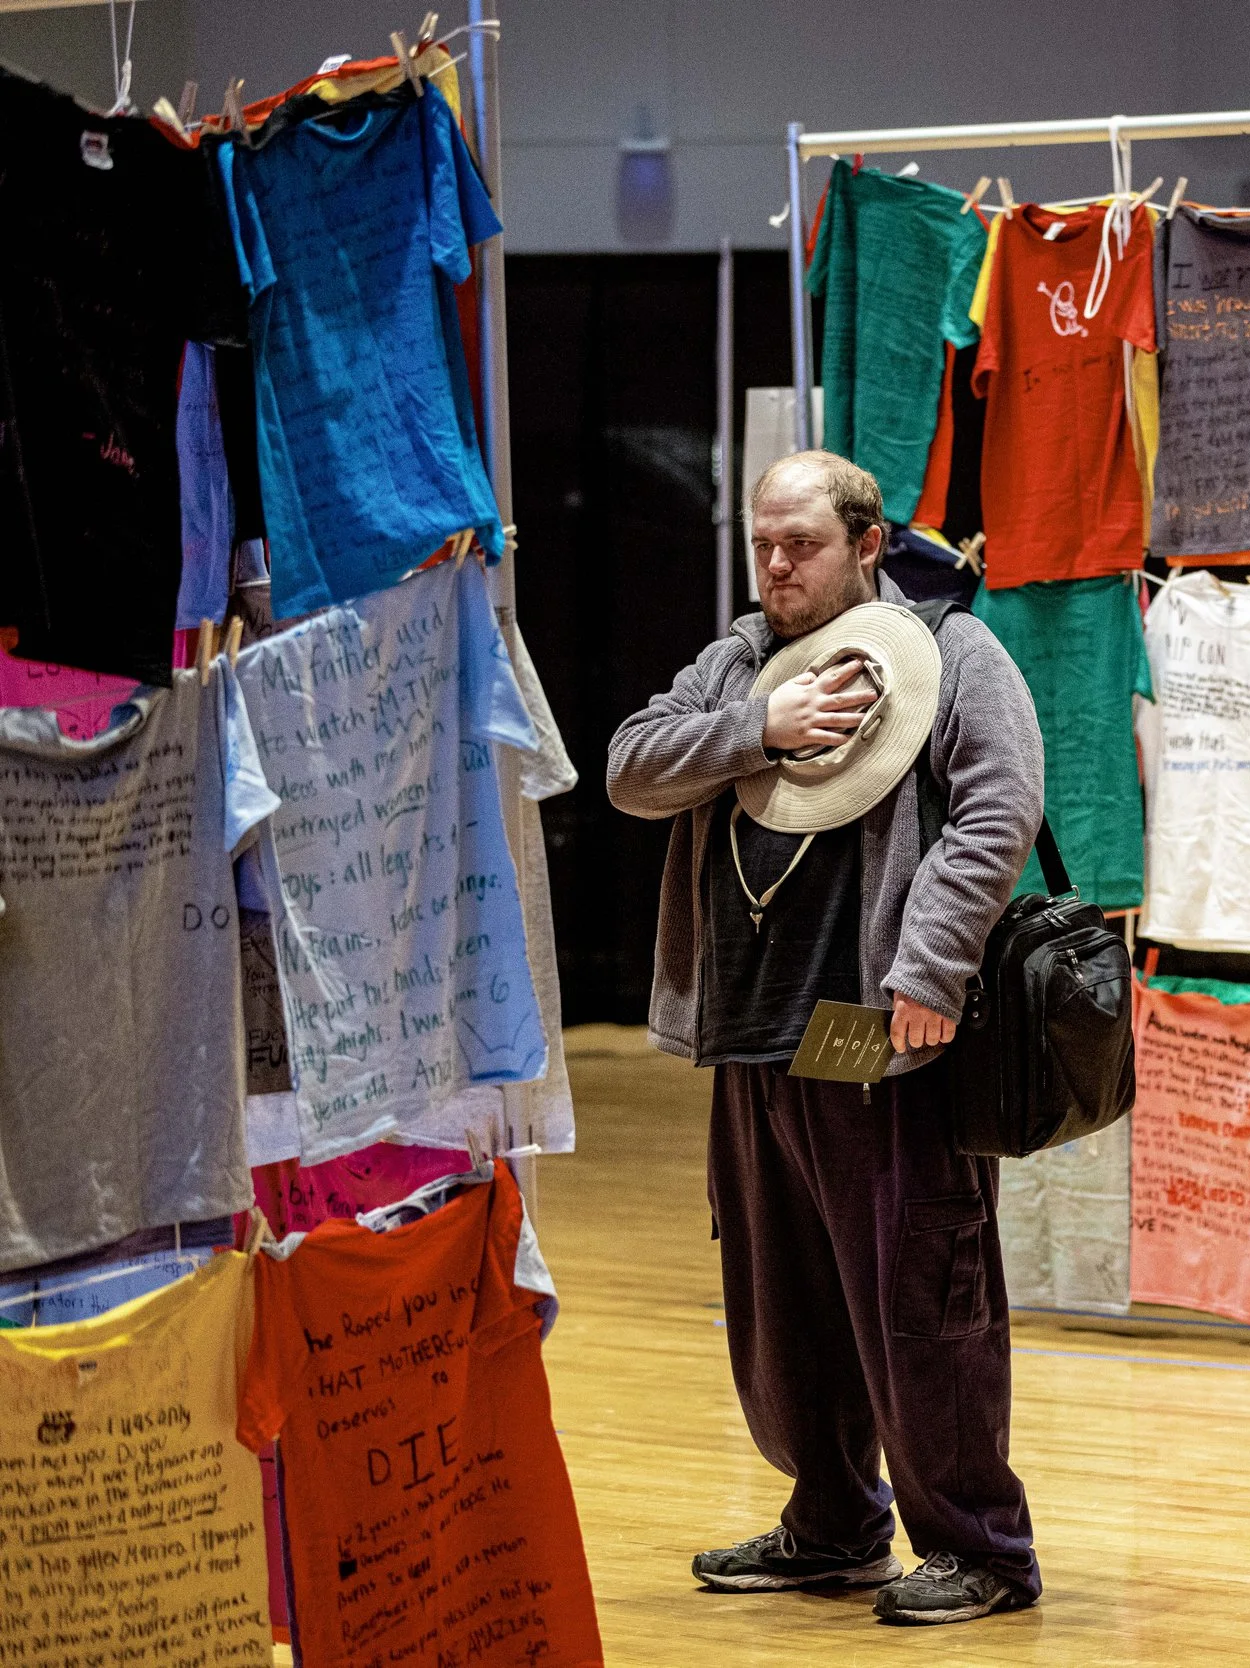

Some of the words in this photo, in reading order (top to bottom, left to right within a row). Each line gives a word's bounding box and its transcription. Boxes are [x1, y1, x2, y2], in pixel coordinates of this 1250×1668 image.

[341, 1301, 392, 1340] Raped
[402, 1290, 438, 1328] you
[366, 1422, 458, 1492] DIE
